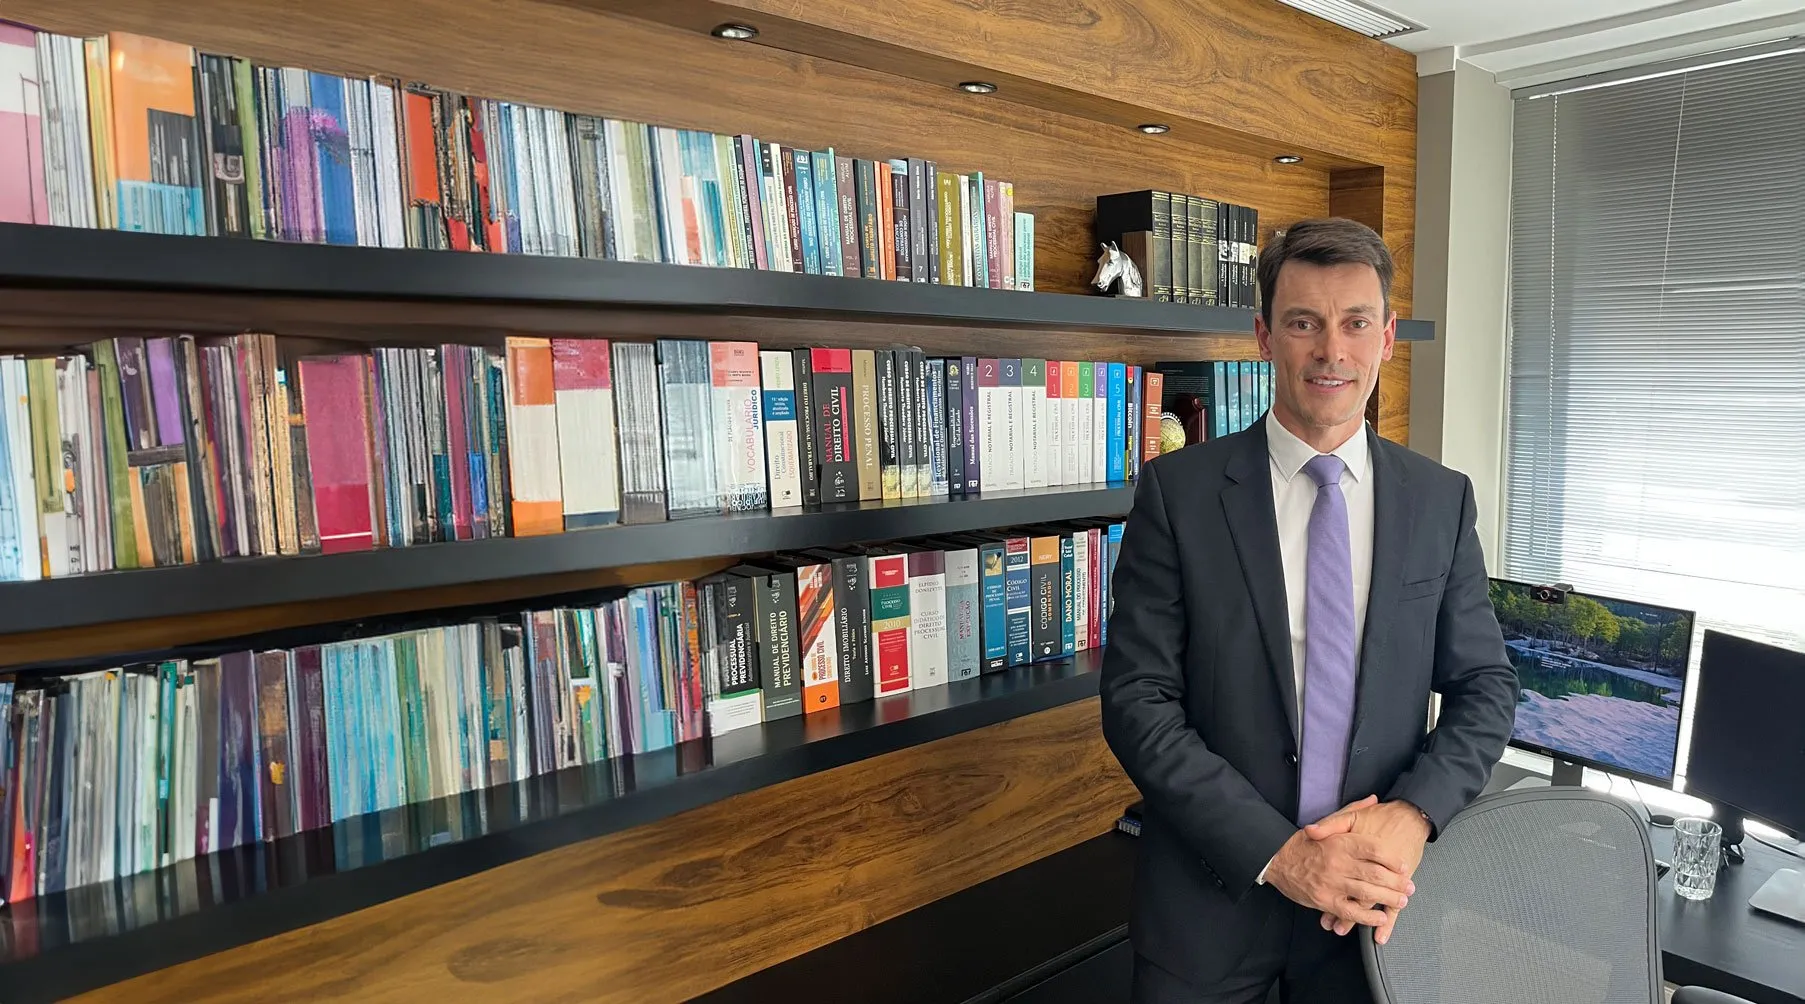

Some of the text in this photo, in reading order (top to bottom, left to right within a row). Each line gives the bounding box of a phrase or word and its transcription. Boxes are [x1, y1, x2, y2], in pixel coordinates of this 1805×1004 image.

[986, 365, 993, 377] 2
[1006, 365, 1014, 377] 3
[1030, 365, 1037, 376] 4
[1052, 384, 1057, 392] 1
[1084, 384, 1089, 393] 3
[1116, 384, 1120, 393] 5
[831, 386, 843, 462] DIREITO CIVIL
[862, 385, 873, 469] PROCESSO PENAL
[823, 403, 833, 462] MANUAL DE
[934, 429, 940, 438] de
[884, 620, 900, 629] 2010
[772, 644, 778, 653] DE
[779, 610, 791, 686] PREVIDENCIÁRIO
[840, 607, 851, 682] DIREITO IMOBILIÁRIO
[737, 623, 746, 683] PREVIDENCIÁRIA
[730, 639, 738, 685] PROCESSUAL
[817, 654, 826, 680] PROCESSO
